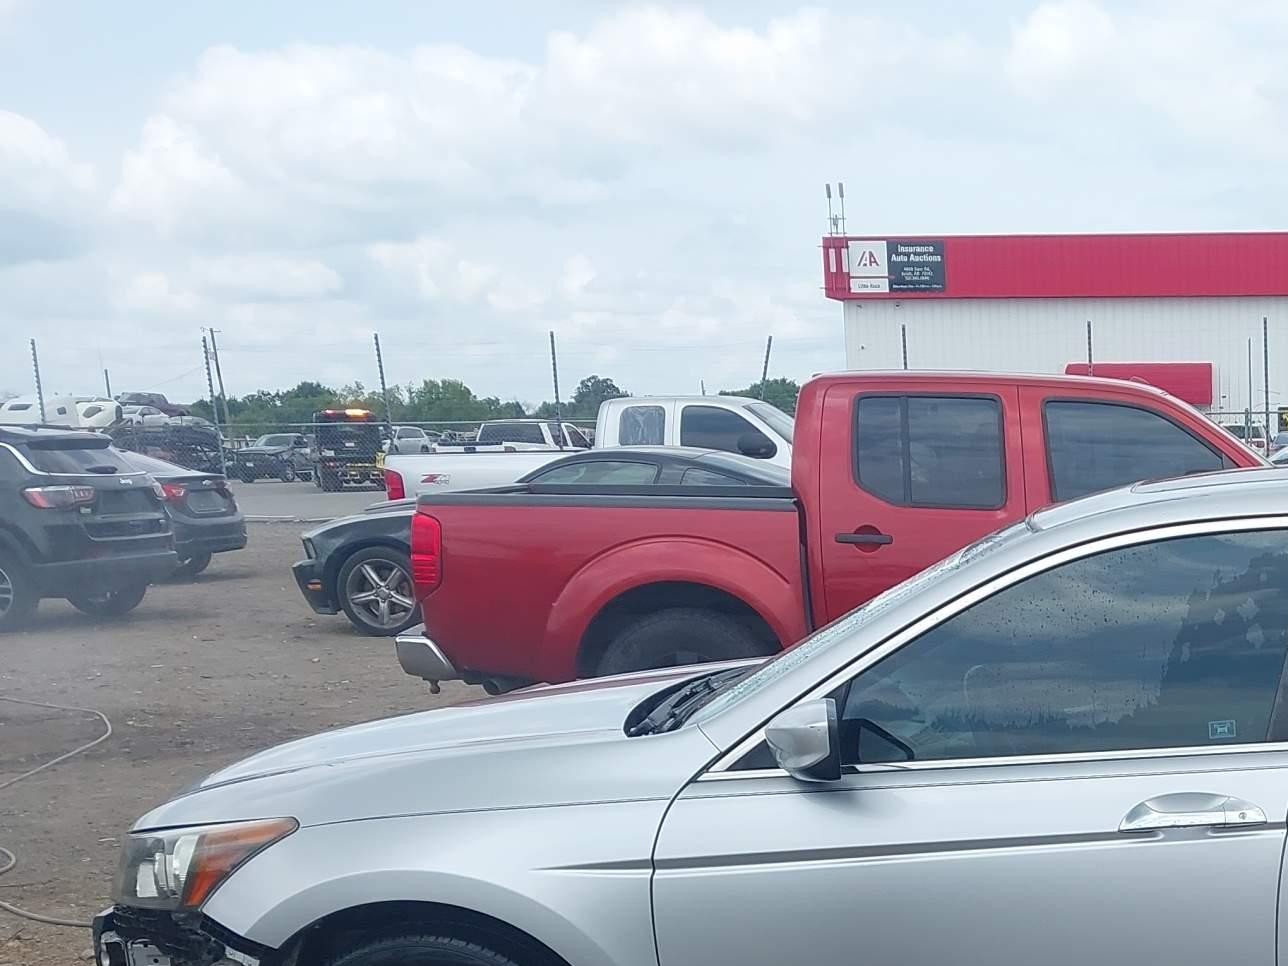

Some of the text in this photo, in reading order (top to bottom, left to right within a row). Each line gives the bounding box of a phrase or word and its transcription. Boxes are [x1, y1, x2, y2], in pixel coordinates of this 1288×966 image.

[898, 244, 934, 253] Insurance
[891, 253, 941, 262] Auto Auctions
